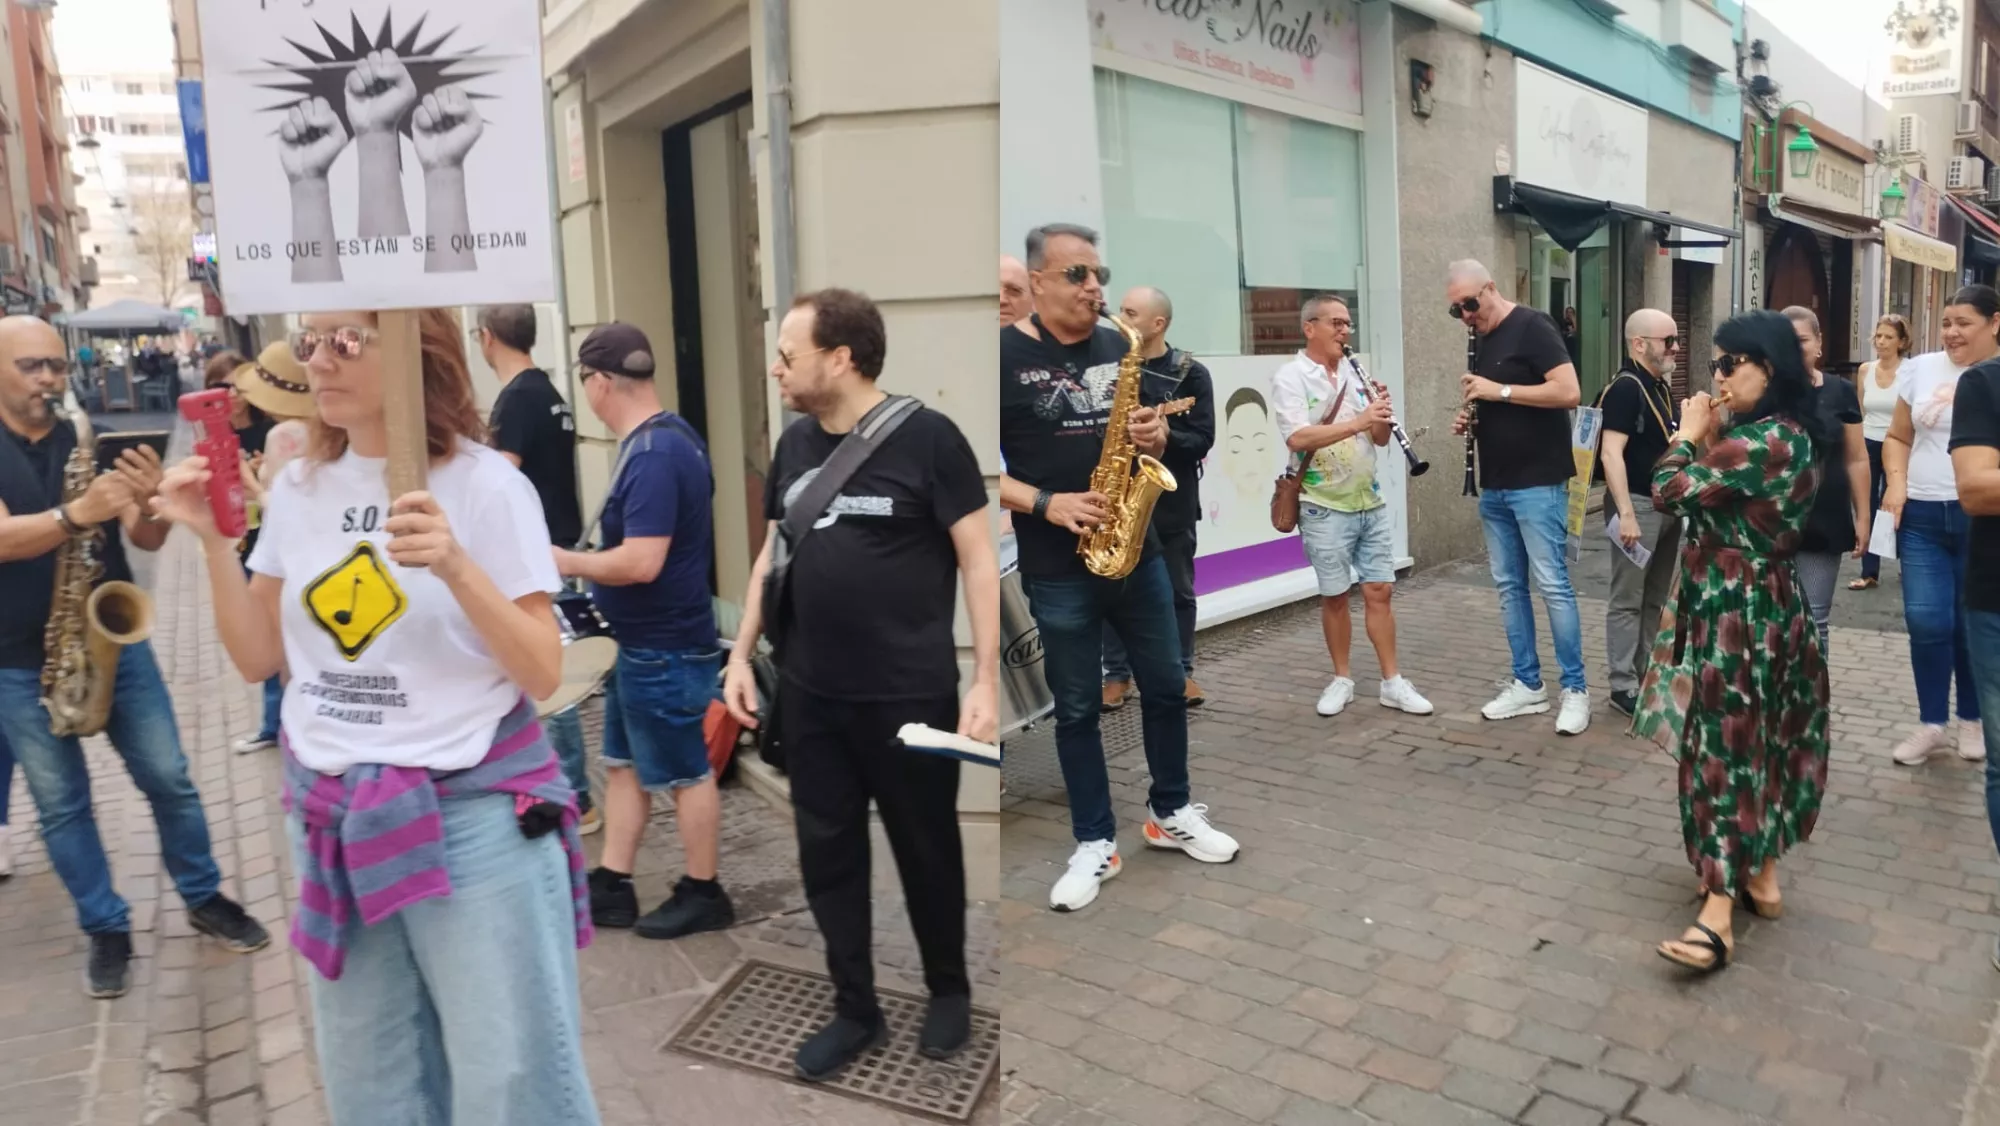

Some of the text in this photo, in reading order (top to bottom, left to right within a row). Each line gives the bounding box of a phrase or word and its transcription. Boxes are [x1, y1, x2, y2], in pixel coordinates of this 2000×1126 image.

[236, 244, 272, 260] LOS
[286, 241, 322, 262] QUE
[336, 235, 399, 256] ESTÁN
[412, 235, 436, 252] SE
[450, 231, 527, 253] QUEDAN
[319, 670, 398, 690] PROFESORADO
[300, 682, 408, 707] CONSERVATORIOS
[316, 703, 383, 725] CANARIAS
